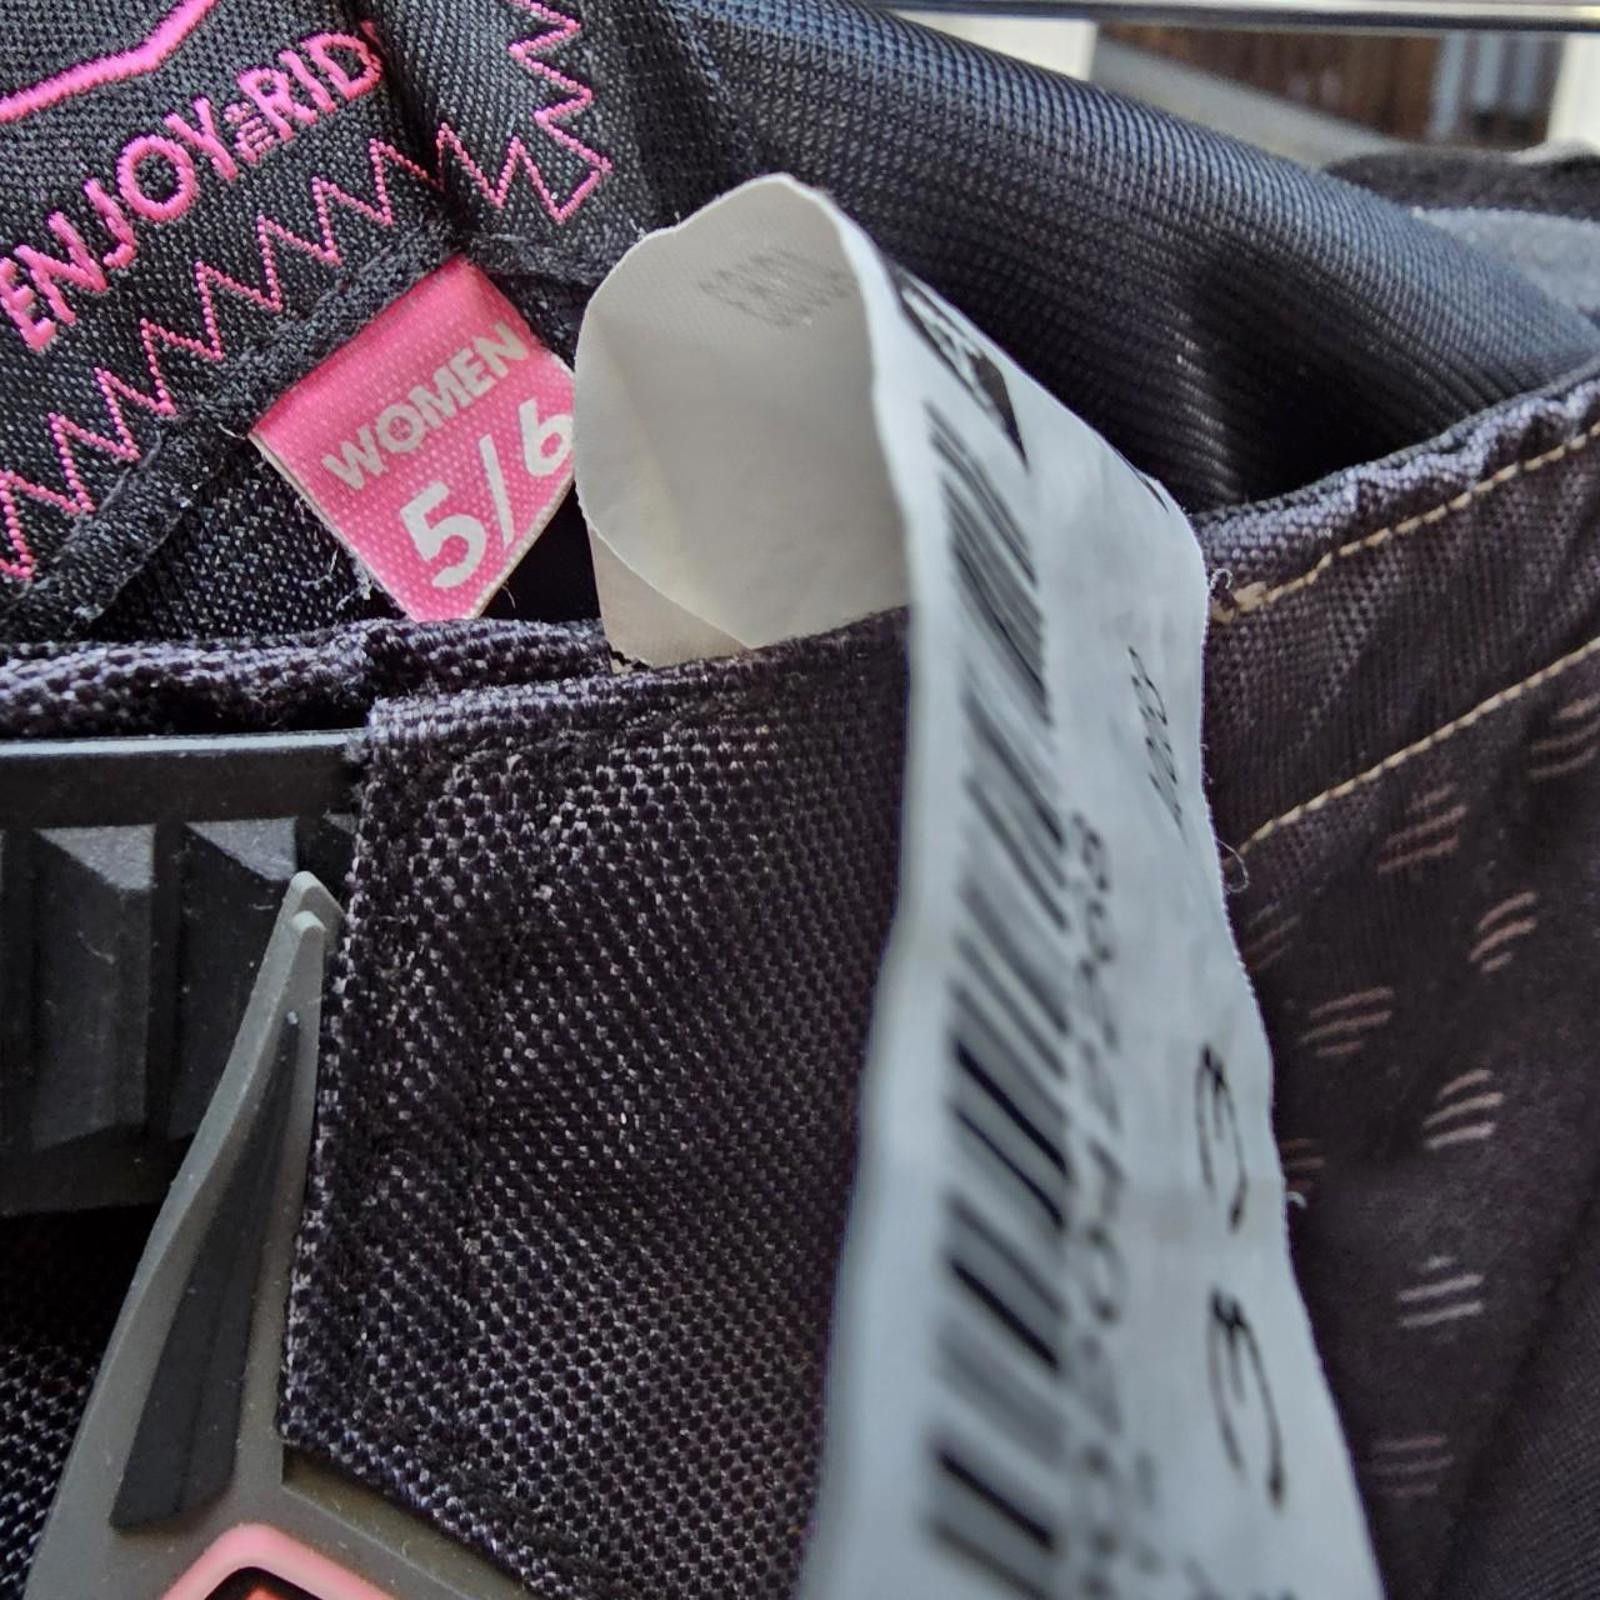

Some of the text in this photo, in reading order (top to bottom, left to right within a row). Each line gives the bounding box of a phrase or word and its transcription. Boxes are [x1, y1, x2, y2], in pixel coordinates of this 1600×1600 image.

[0, 95, 239, 351] ENJOY
[237, 22, 385, 142] RID
[321, 320, 529, 491] WOMEN
[399, 398, 575, 588] 5/6
